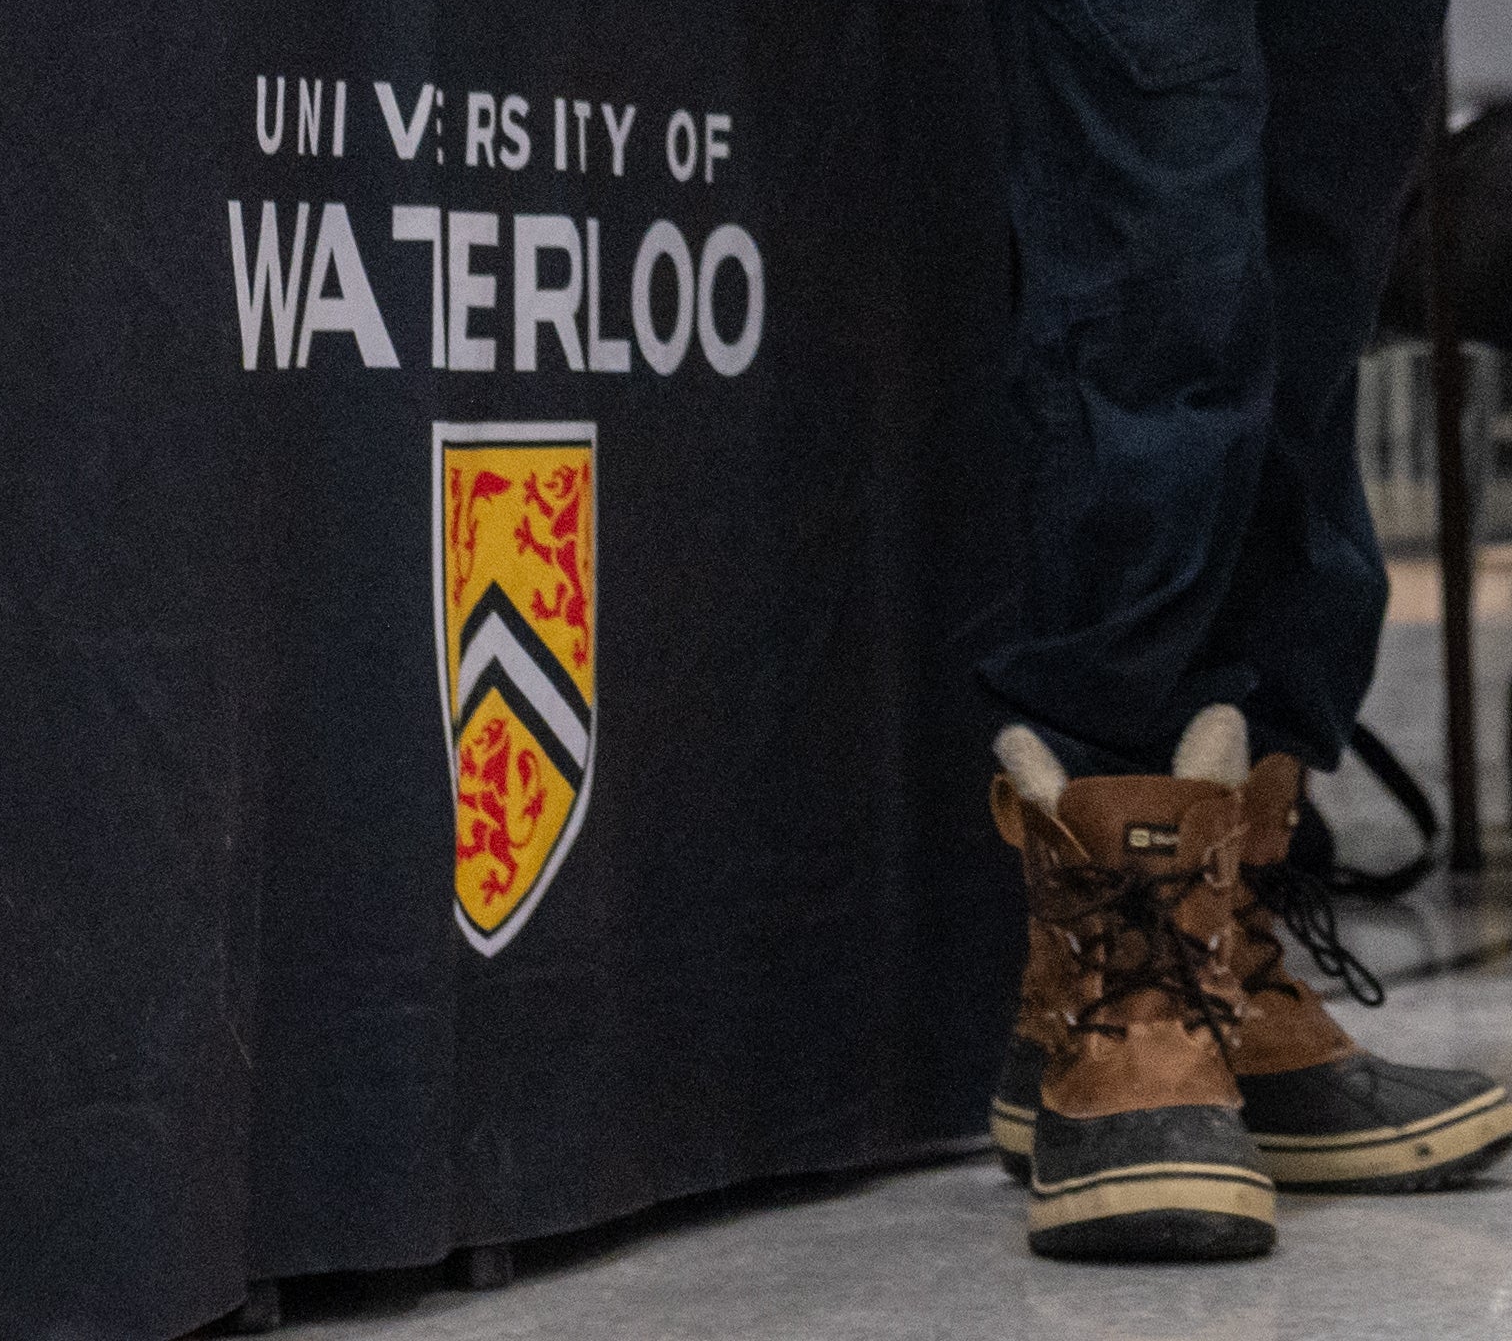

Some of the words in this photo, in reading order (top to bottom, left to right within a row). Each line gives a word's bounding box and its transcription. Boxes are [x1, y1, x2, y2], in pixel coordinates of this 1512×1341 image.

[256, 75, 636, 178] UNIVRSITY
[665, 110, 732, 183] OF
[227, 200, 766, 377] WATERLOO
